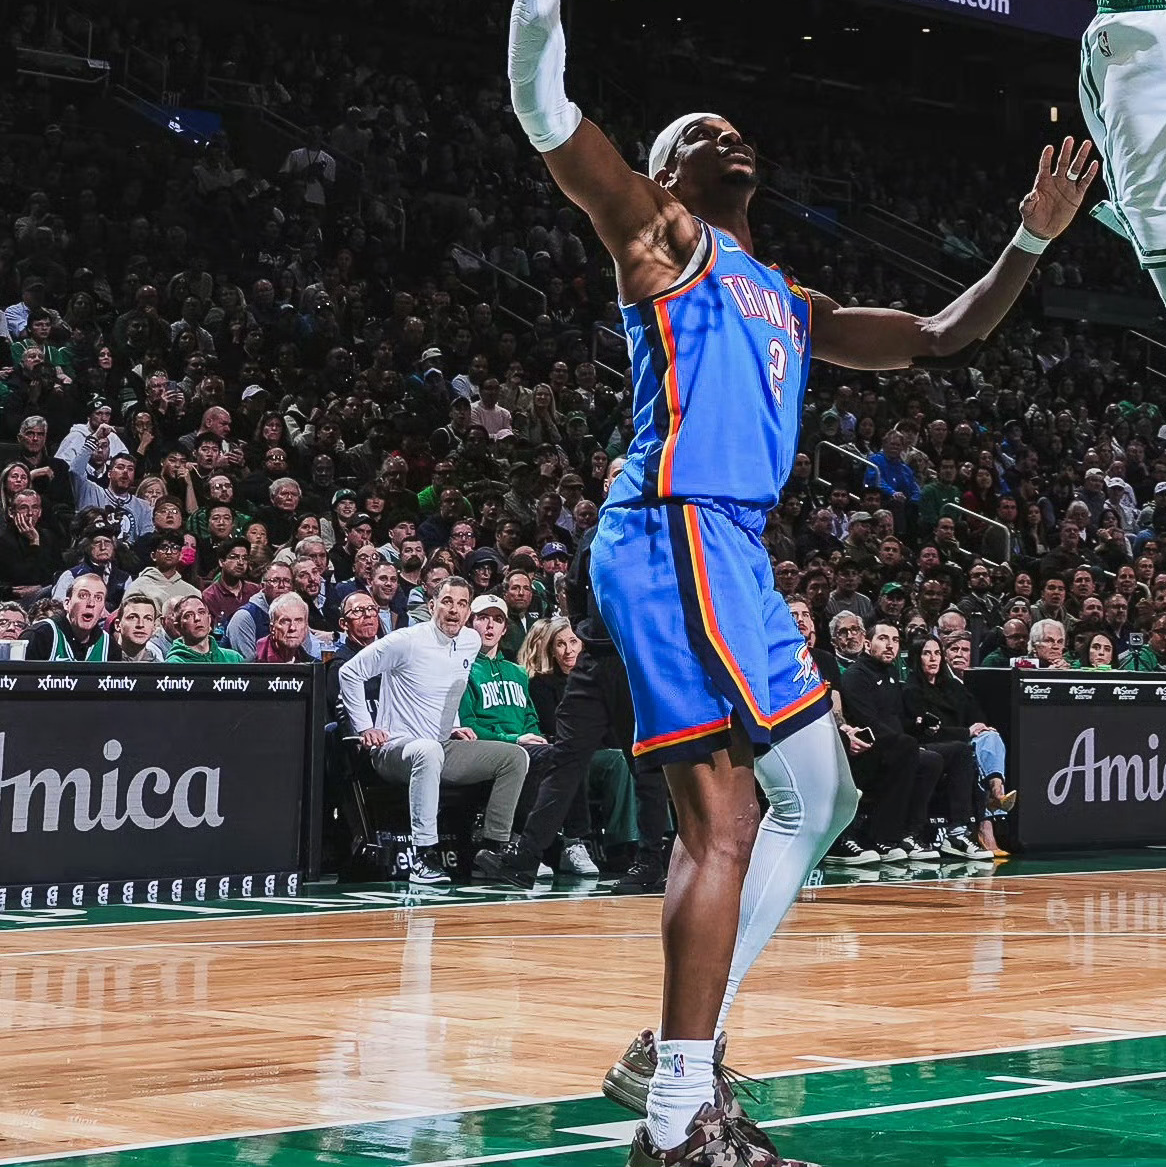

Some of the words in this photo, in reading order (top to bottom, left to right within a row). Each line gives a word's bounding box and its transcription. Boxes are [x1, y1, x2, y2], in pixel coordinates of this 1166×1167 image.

[768, 337, 788, 410] 2
[38, 674, 78, 691] xfinity
[98, 675, 137, 691] xfinity
[156, 675, 194, 691] xfinity
[213, 676, 249, 692] xfinity
[268, 677, 303, 692] xfinity
[480, 679, 527, 710] BOSTON
[0, 732, 225, 832] mica
